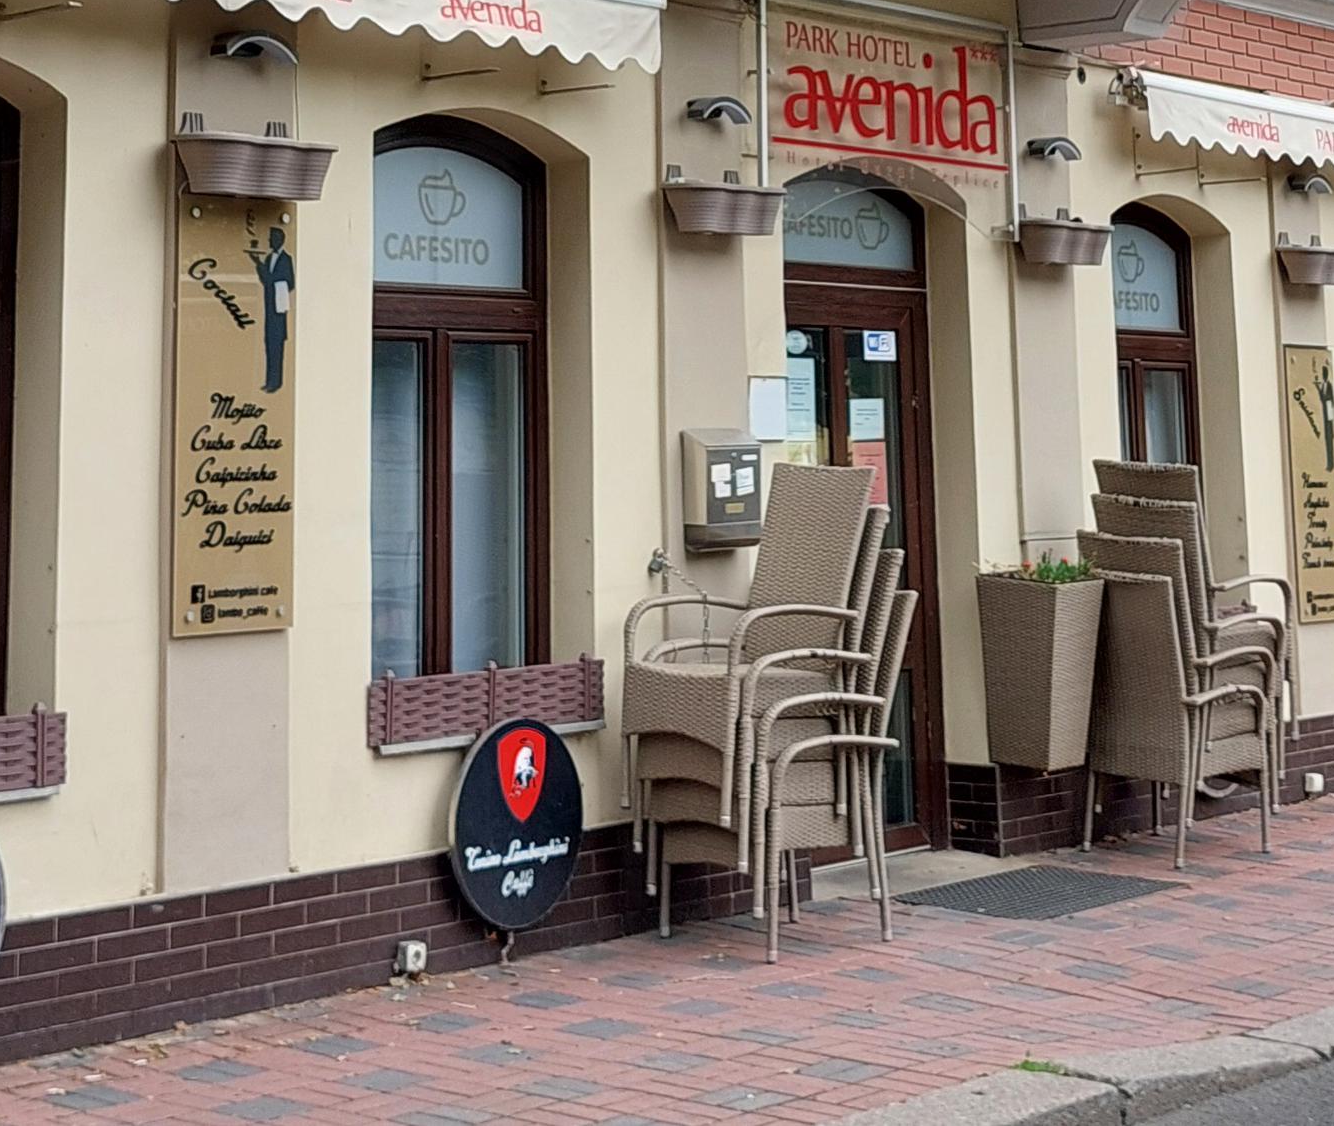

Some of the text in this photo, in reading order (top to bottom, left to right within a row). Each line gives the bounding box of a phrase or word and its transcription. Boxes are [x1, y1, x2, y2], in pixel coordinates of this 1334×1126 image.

[784, 20, 916, 69] PARK HOTEL
[783, 46, 999, 156] avenida
[1226, 113, 1281, 144] avenida
[383, 232, 490, 267] CAFESITO
[1115, 289, 1161, 313] FESITO
[210, 392, 267, 425] Mojito
[191, 424, 284, 452] Cuba Libre
[233, 487, 293, 515] Colada
